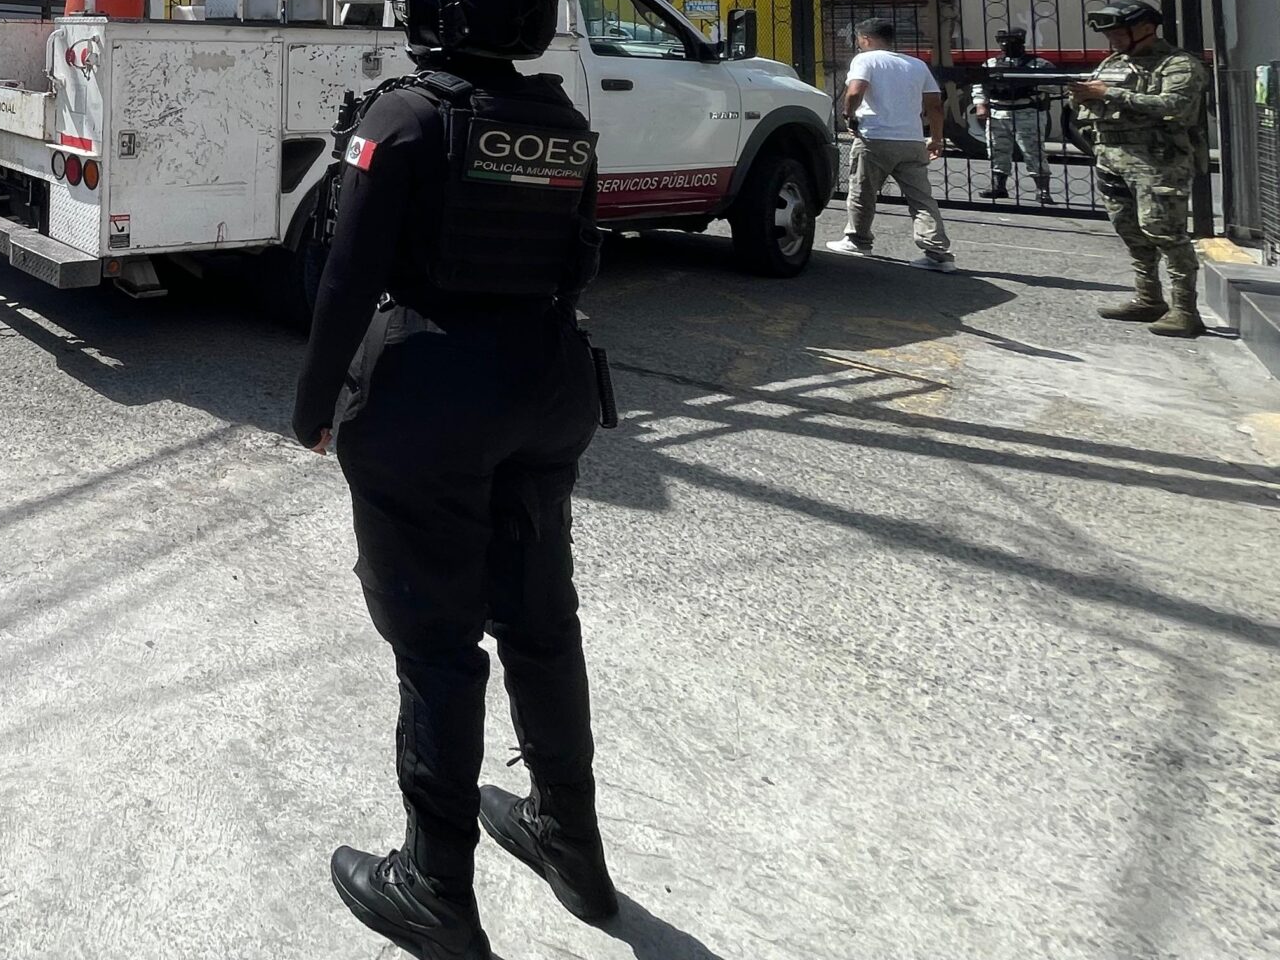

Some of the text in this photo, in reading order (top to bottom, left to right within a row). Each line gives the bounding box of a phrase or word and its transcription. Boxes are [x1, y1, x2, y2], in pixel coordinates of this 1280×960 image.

[479, 130, 591, 165] GOES
[473, 160, 583, 178] POLICÍA MUNICIPAL
[597, 171, 718, 193] SERVICIOS PÚBLICOS
